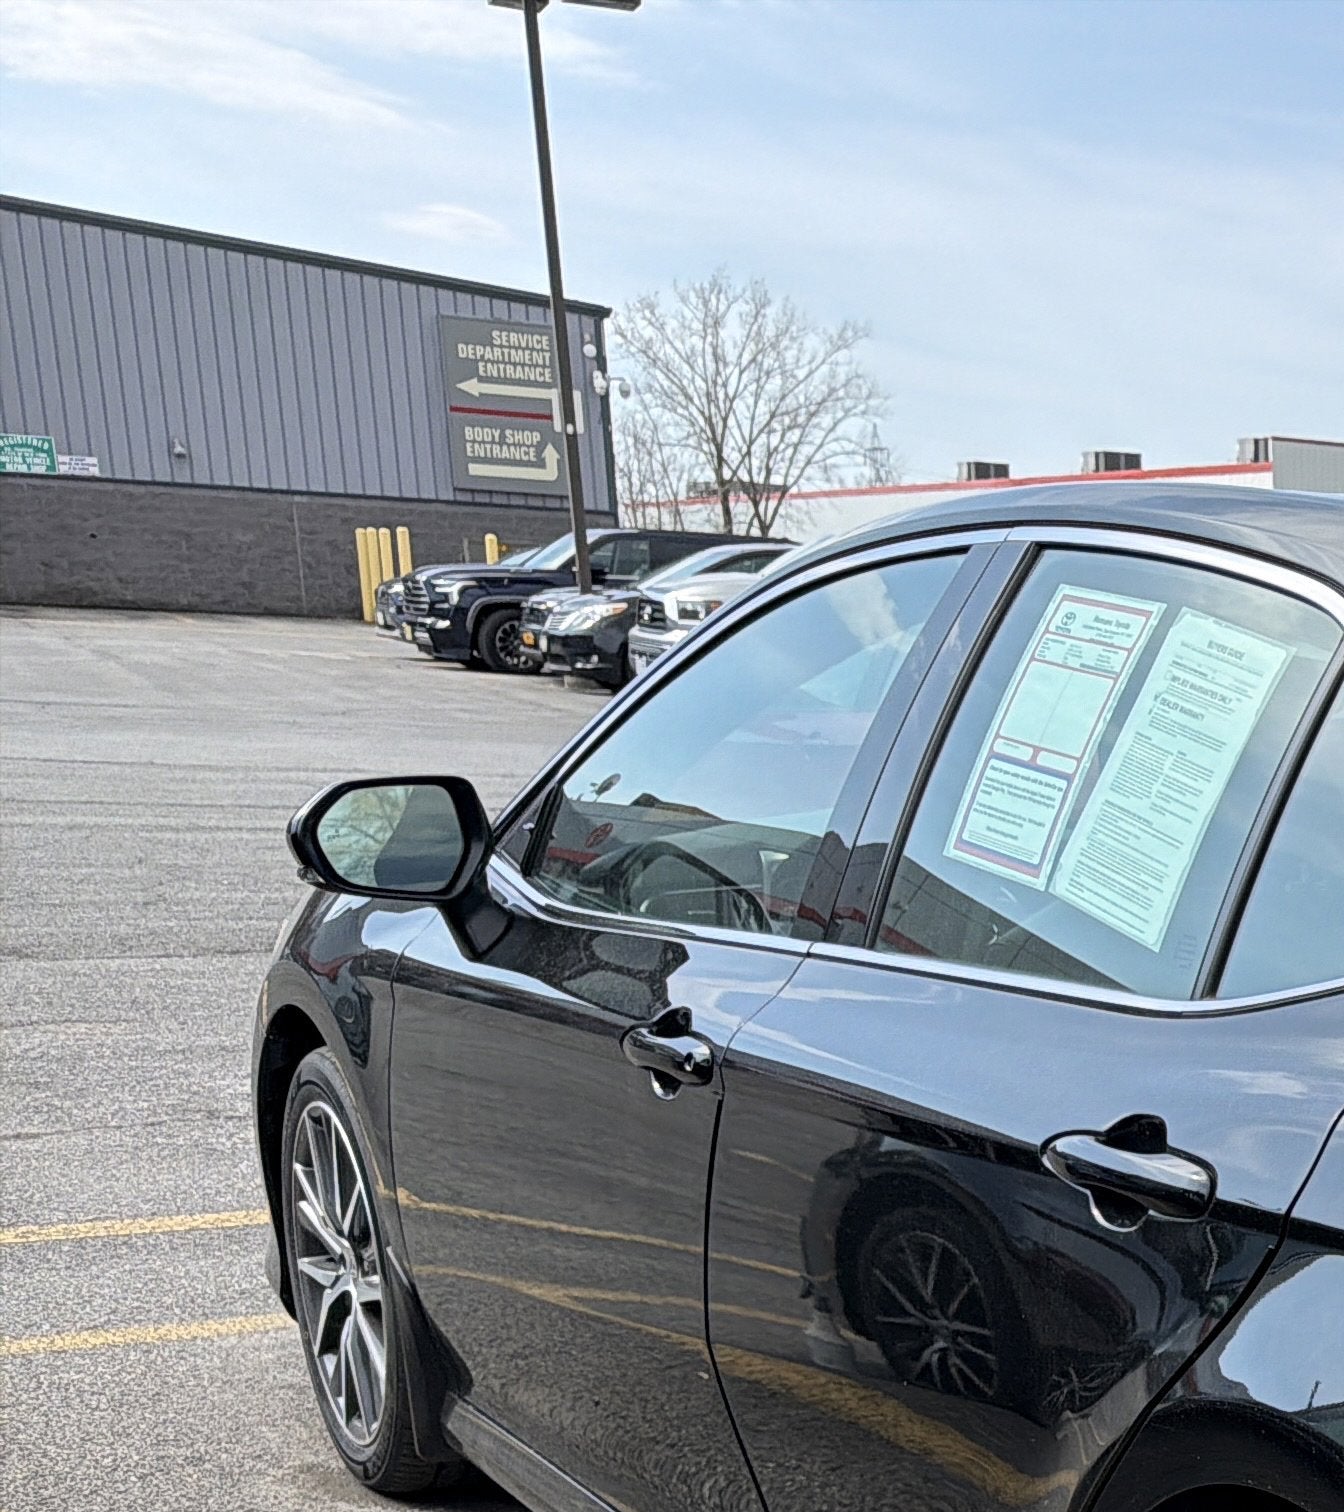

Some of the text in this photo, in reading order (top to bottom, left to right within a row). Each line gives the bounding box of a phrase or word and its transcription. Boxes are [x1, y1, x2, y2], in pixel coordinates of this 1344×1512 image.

[491, 330, 549, 350] SERVICE
[457, 343, 551, 366] DEPARTMENT
[478, 362, 553, 382] ENTRANCE
[464, 426, 541, 446] BODY SHOP
[465, 442, 537, 462] ENTRANCE
